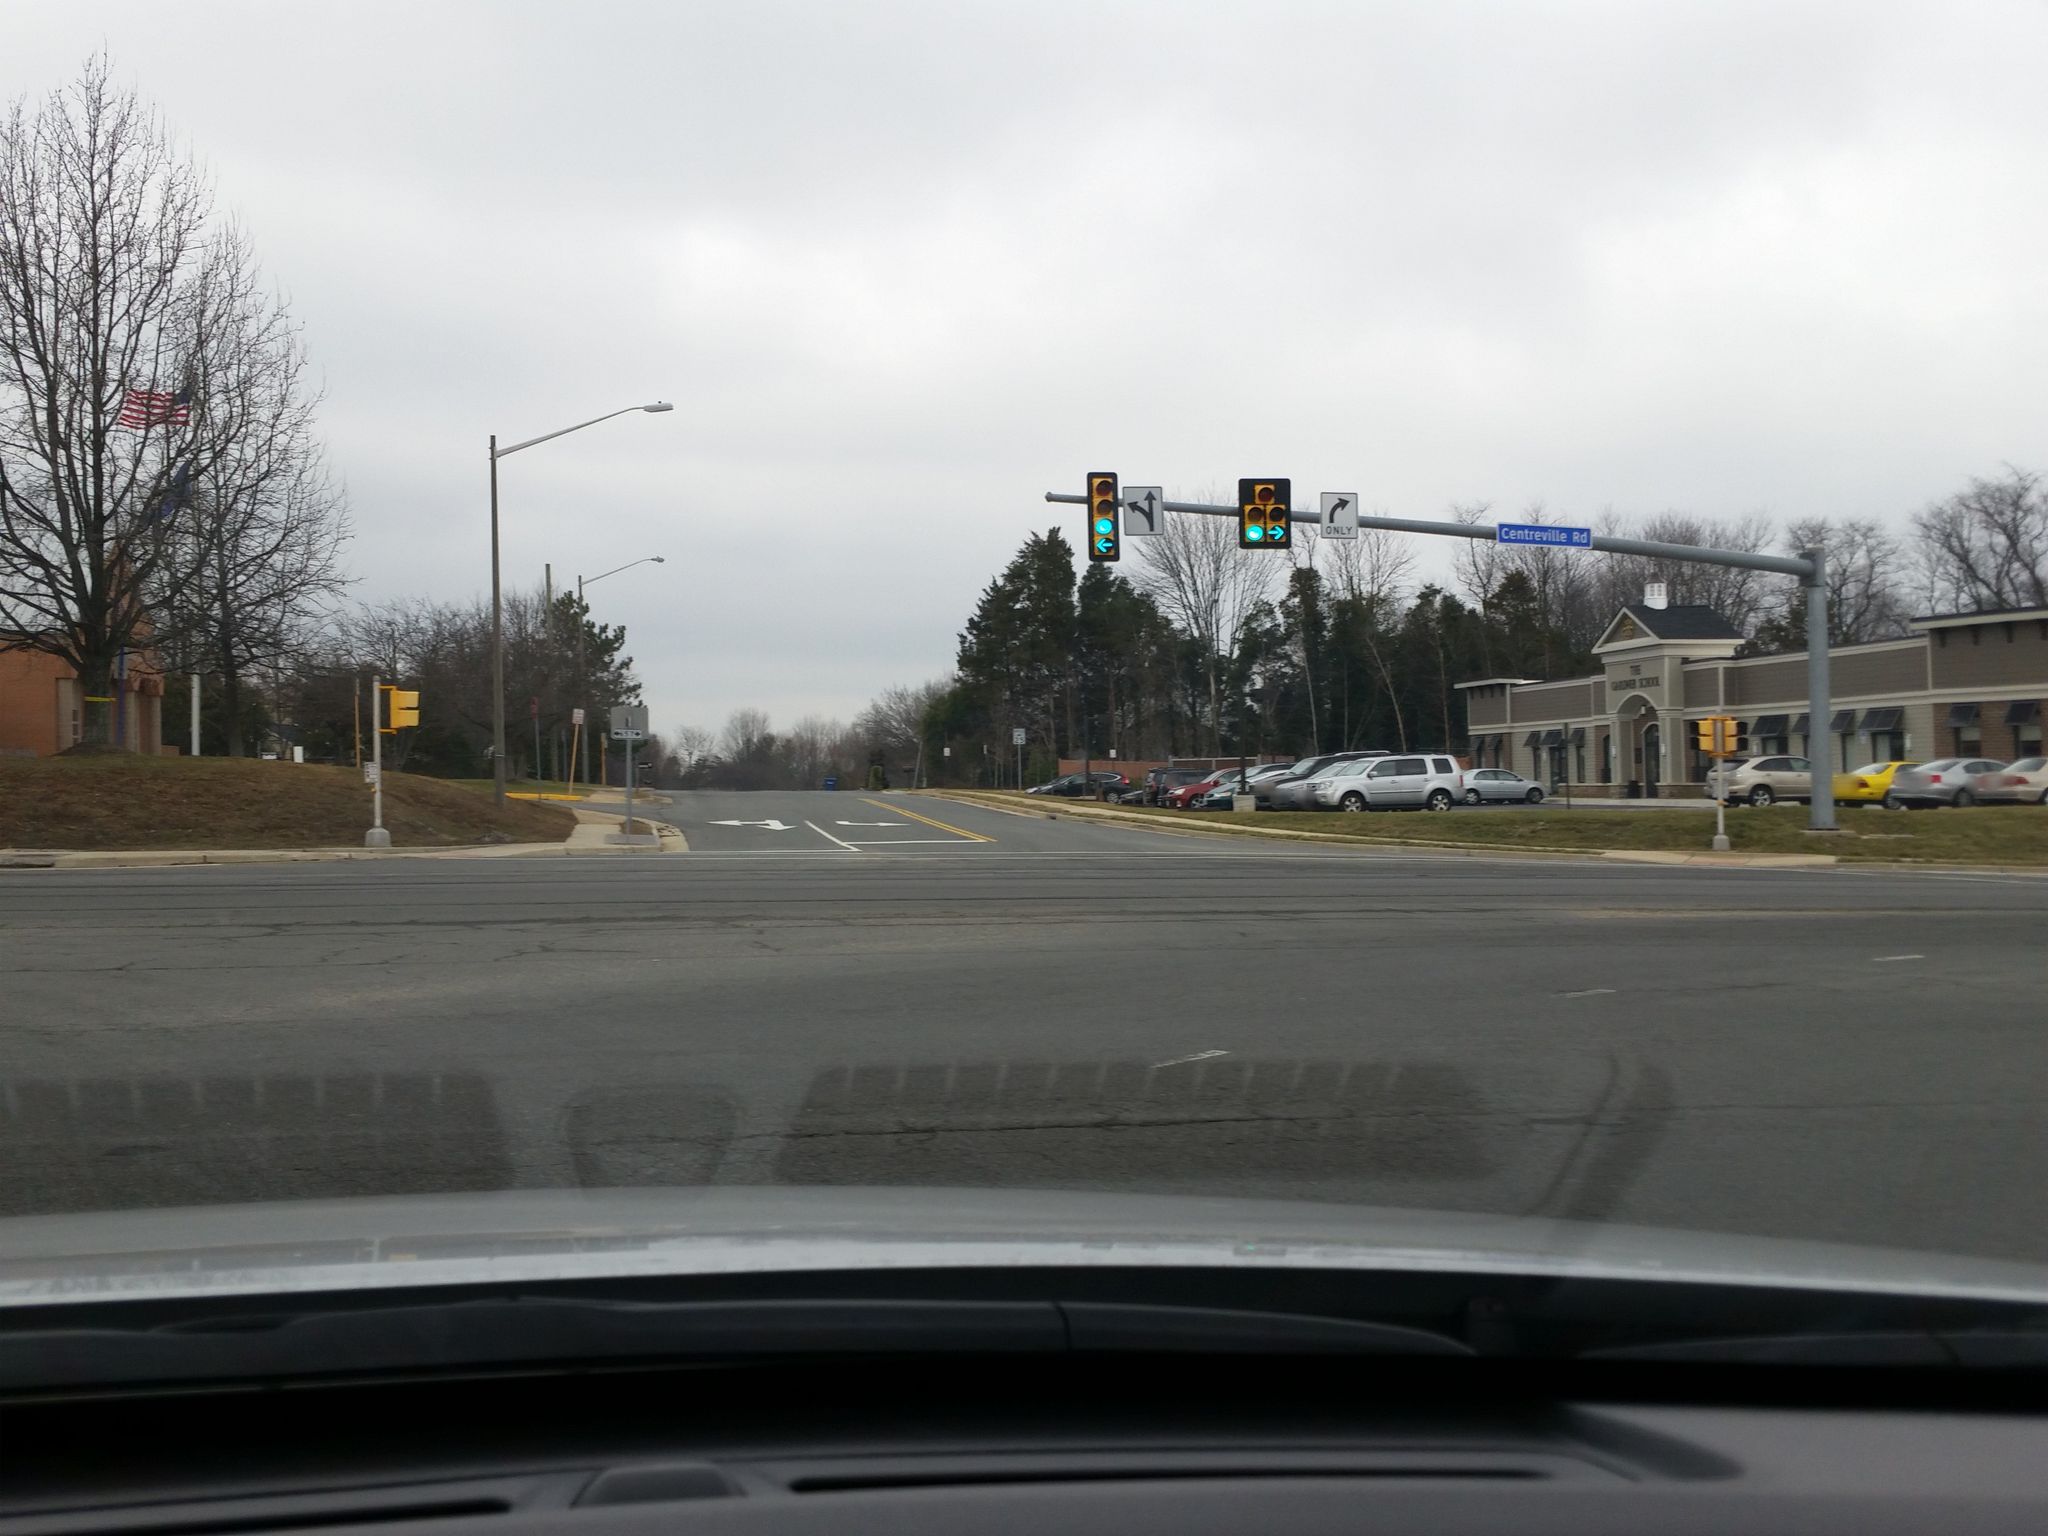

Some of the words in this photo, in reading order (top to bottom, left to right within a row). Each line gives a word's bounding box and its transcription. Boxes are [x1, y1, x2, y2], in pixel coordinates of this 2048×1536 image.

[1325, 525, 1353, 535] ONLY
[1501, 527, 1567, 542] Centreville
[1572, 531, 1588, 543] Rd
